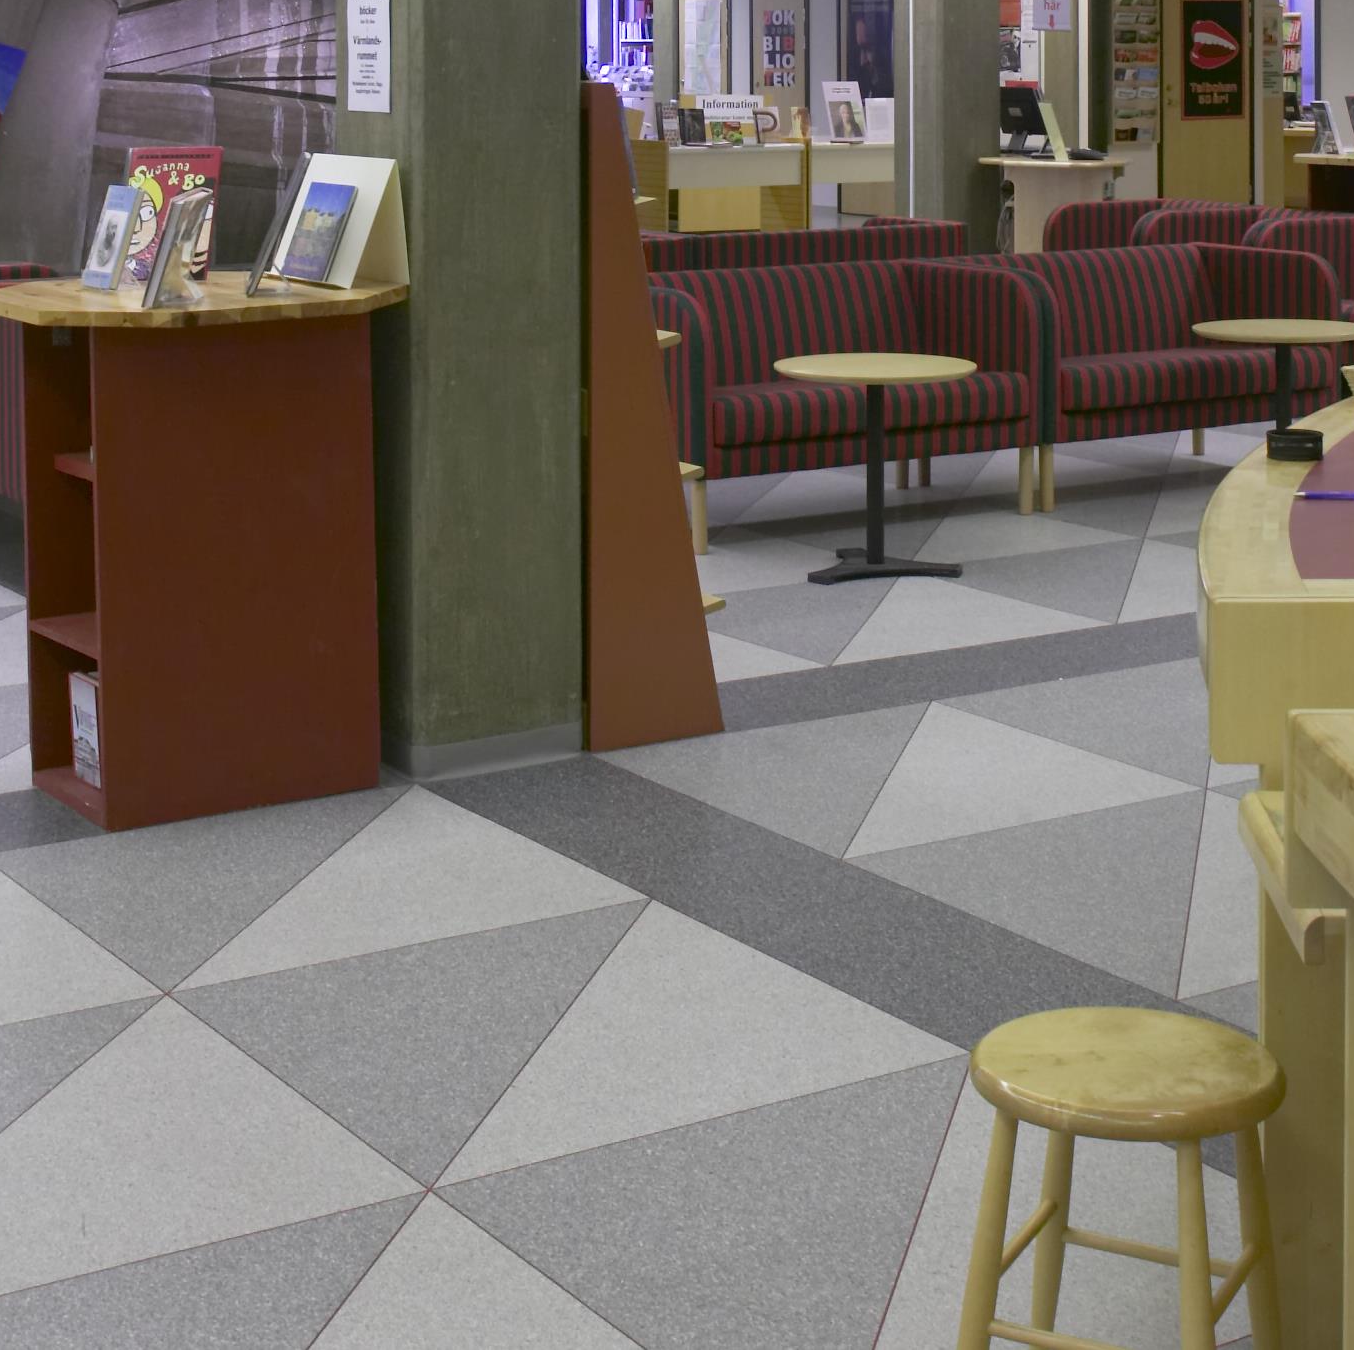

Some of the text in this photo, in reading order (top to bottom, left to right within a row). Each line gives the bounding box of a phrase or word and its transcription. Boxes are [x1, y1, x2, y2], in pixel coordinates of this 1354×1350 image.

[1043, 0, 1061, 11] här
[764, 53, 795, 69] LIO
[702, 99, 759, 109] Information
[168, 170, 179, 185] &
